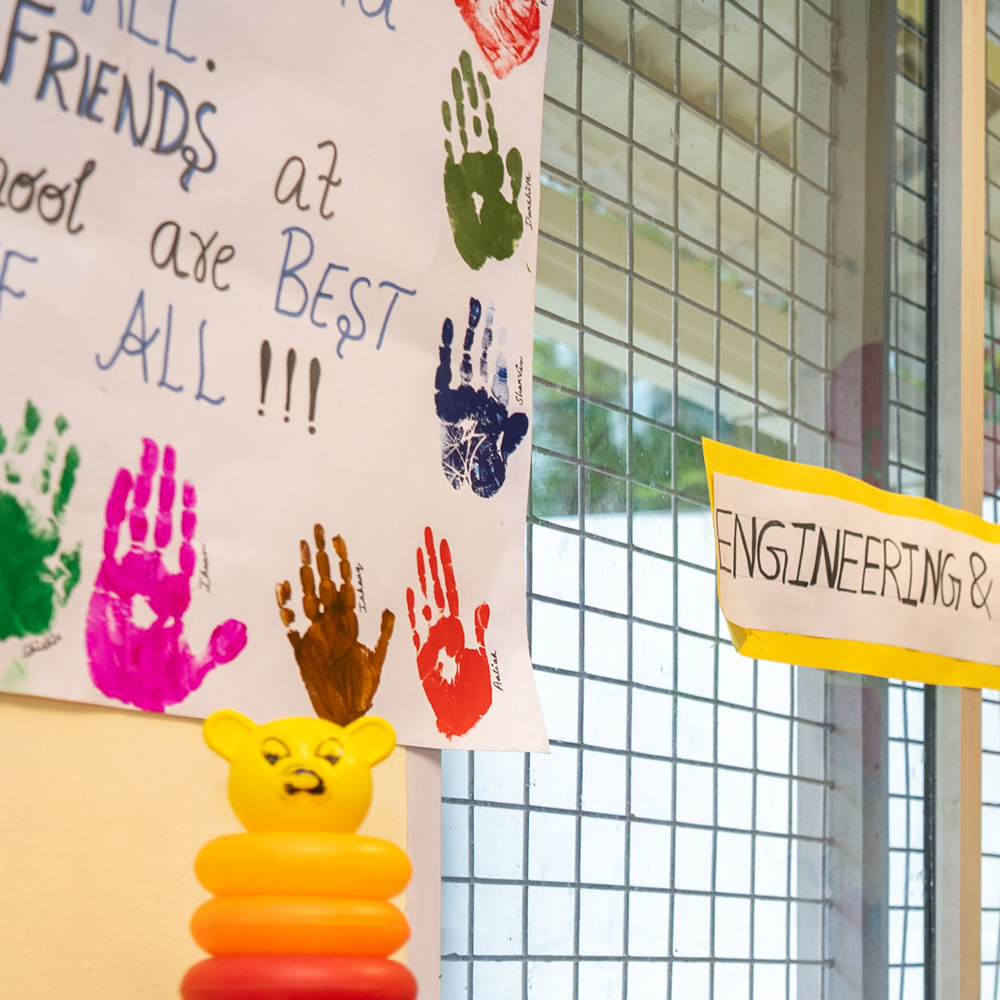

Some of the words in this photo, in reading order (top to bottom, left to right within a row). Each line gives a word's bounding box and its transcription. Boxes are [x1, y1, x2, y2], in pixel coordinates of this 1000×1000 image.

[0, 0, 217, 193] FRIENDS
[274, 139, 343, 221] at
[96, 289, 226, 406] ALL
[150, 220, 236, 292] are
[275, 226, 417, 360] BEST
[715, 508, 962, 611] ENGINEERING
[969, 551, 993, 621] &
